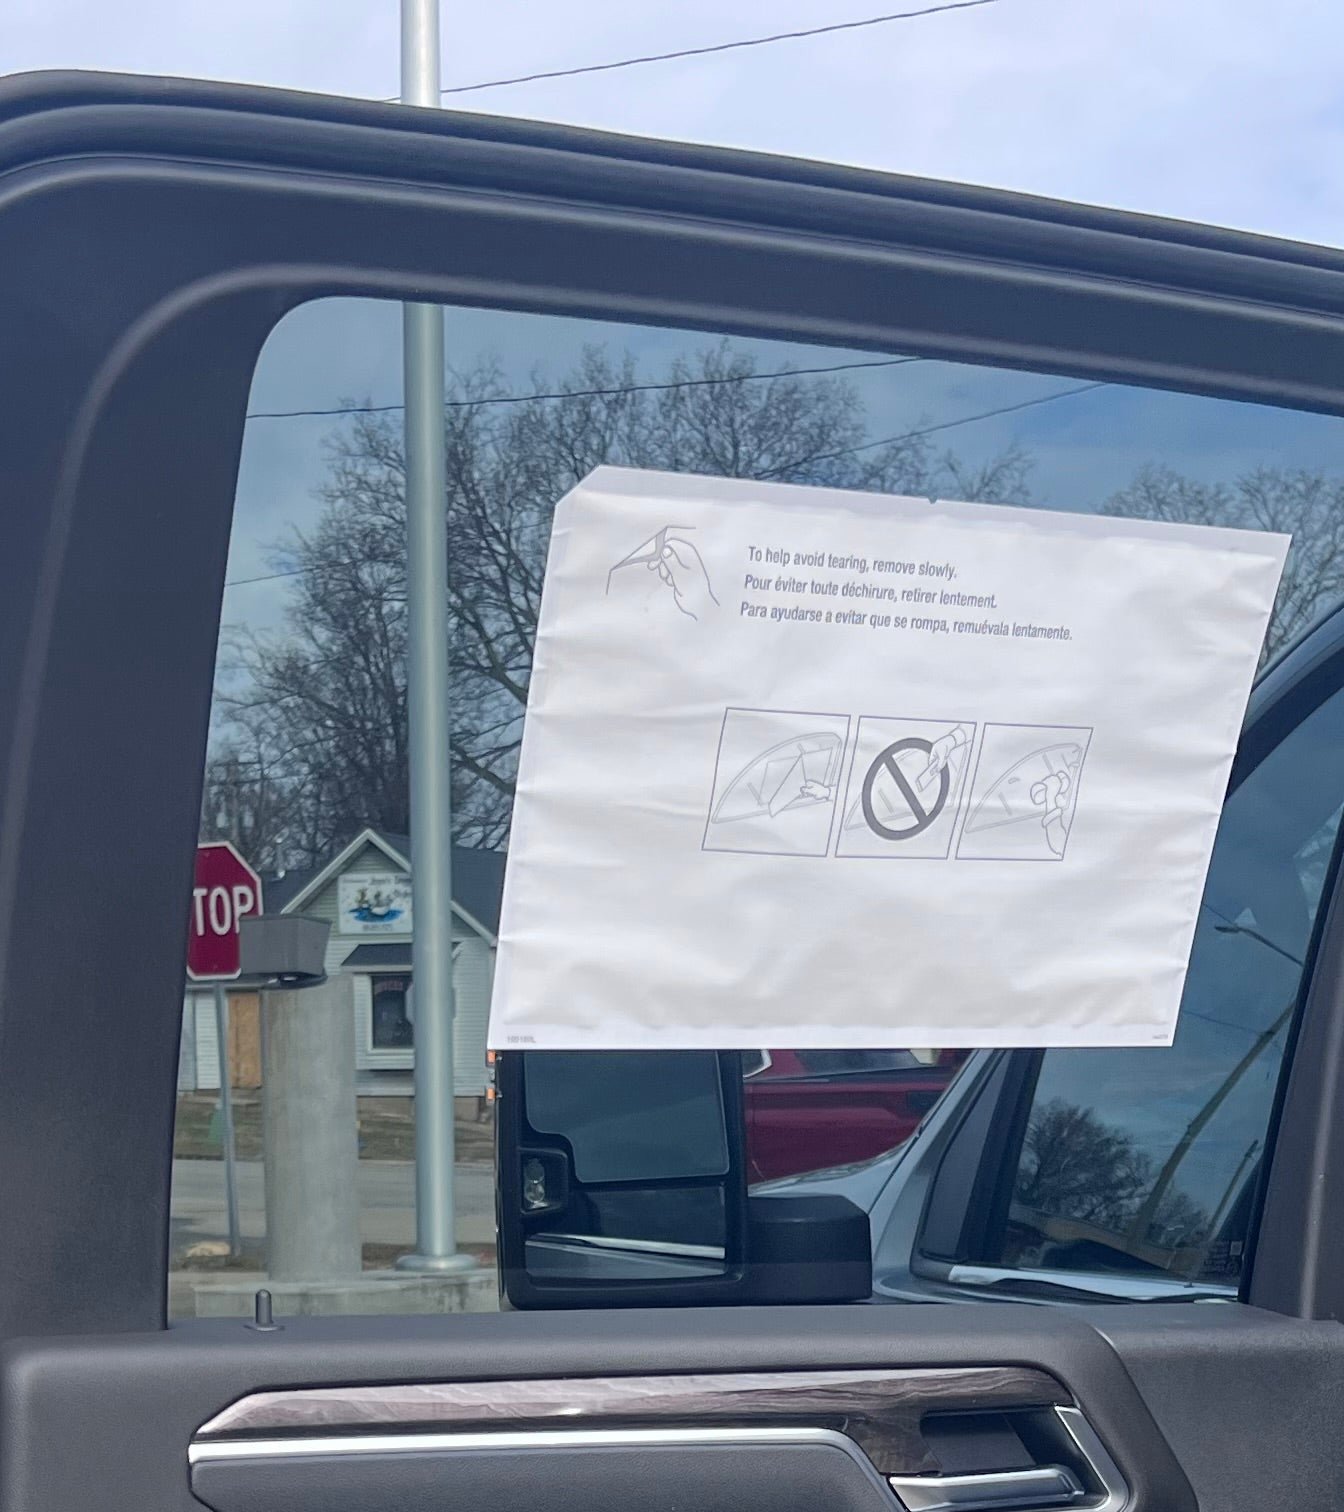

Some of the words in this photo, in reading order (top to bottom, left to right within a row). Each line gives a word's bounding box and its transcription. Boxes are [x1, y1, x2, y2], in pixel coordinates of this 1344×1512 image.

[748, 545, 762, 562] To
[766, 547, 790, 567] help
[794, 551, 825, 568] avoid
[828, 554, 869, 574] tearing,
[873, 559, 915, 576] remove
[918, 561, 957, 581] slowly.
[744, 573, 773, 591] Pour
[775, 575, 808, 593] éviter
[810, 580, 839, 596] toute
[841, 581, 898, 603] déchirure,
[901, 587, 938, 604] retirer
[939, 589, 998, 609] lentement.
[740, 601, 767, 618] Para
[770, 605, 823, 623] ayudarse
[825, 610, 832, 623] a
[835, 610, 868, 625] evitar
[870, 613, 891, 629] que
[894, 616, 908, 629] se
[910, 616, 950, 635] rompa,
[953, 619, 1009, 637] remuévala
[1011, 622, 1073, 641] lentamente.
[192, 885, 255, 937] TOP
